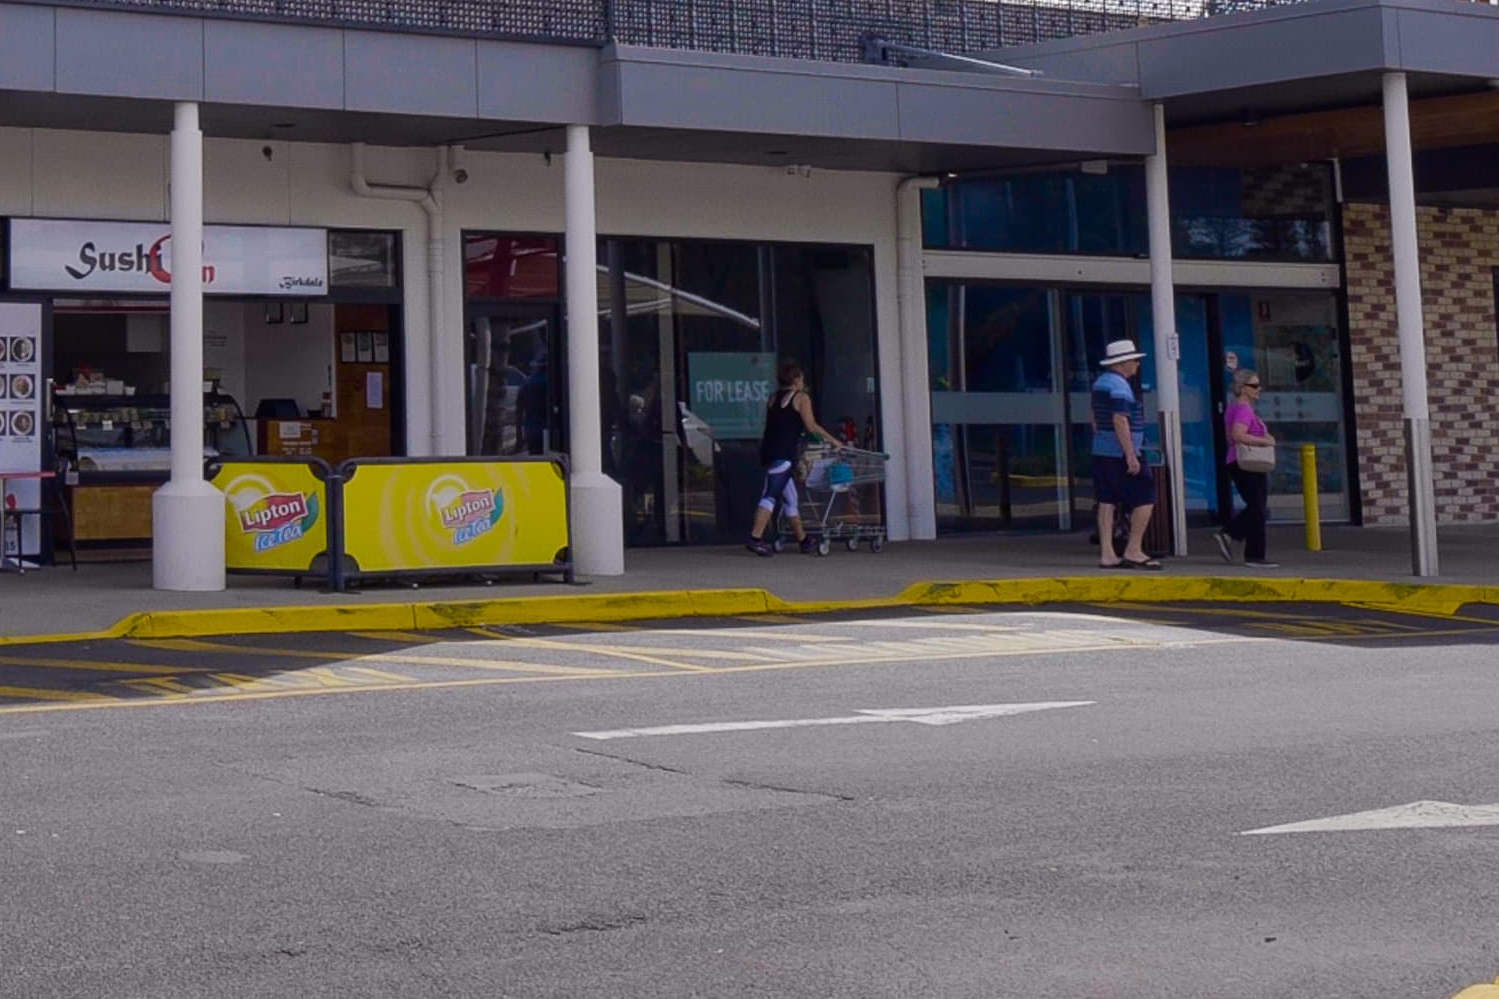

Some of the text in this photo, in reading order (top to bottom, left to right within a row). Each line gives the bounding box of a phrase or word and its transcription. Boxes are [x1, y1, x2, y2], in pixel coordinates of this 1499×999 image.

[64, 241, 164, 280] Sushi
[278, 276, 323, 289] Birkdale
[695, 380, 770, 403] FOR LEASE
[244, 500, 301, 526] Lipton
[445, 497, 490, 521] Lipton
